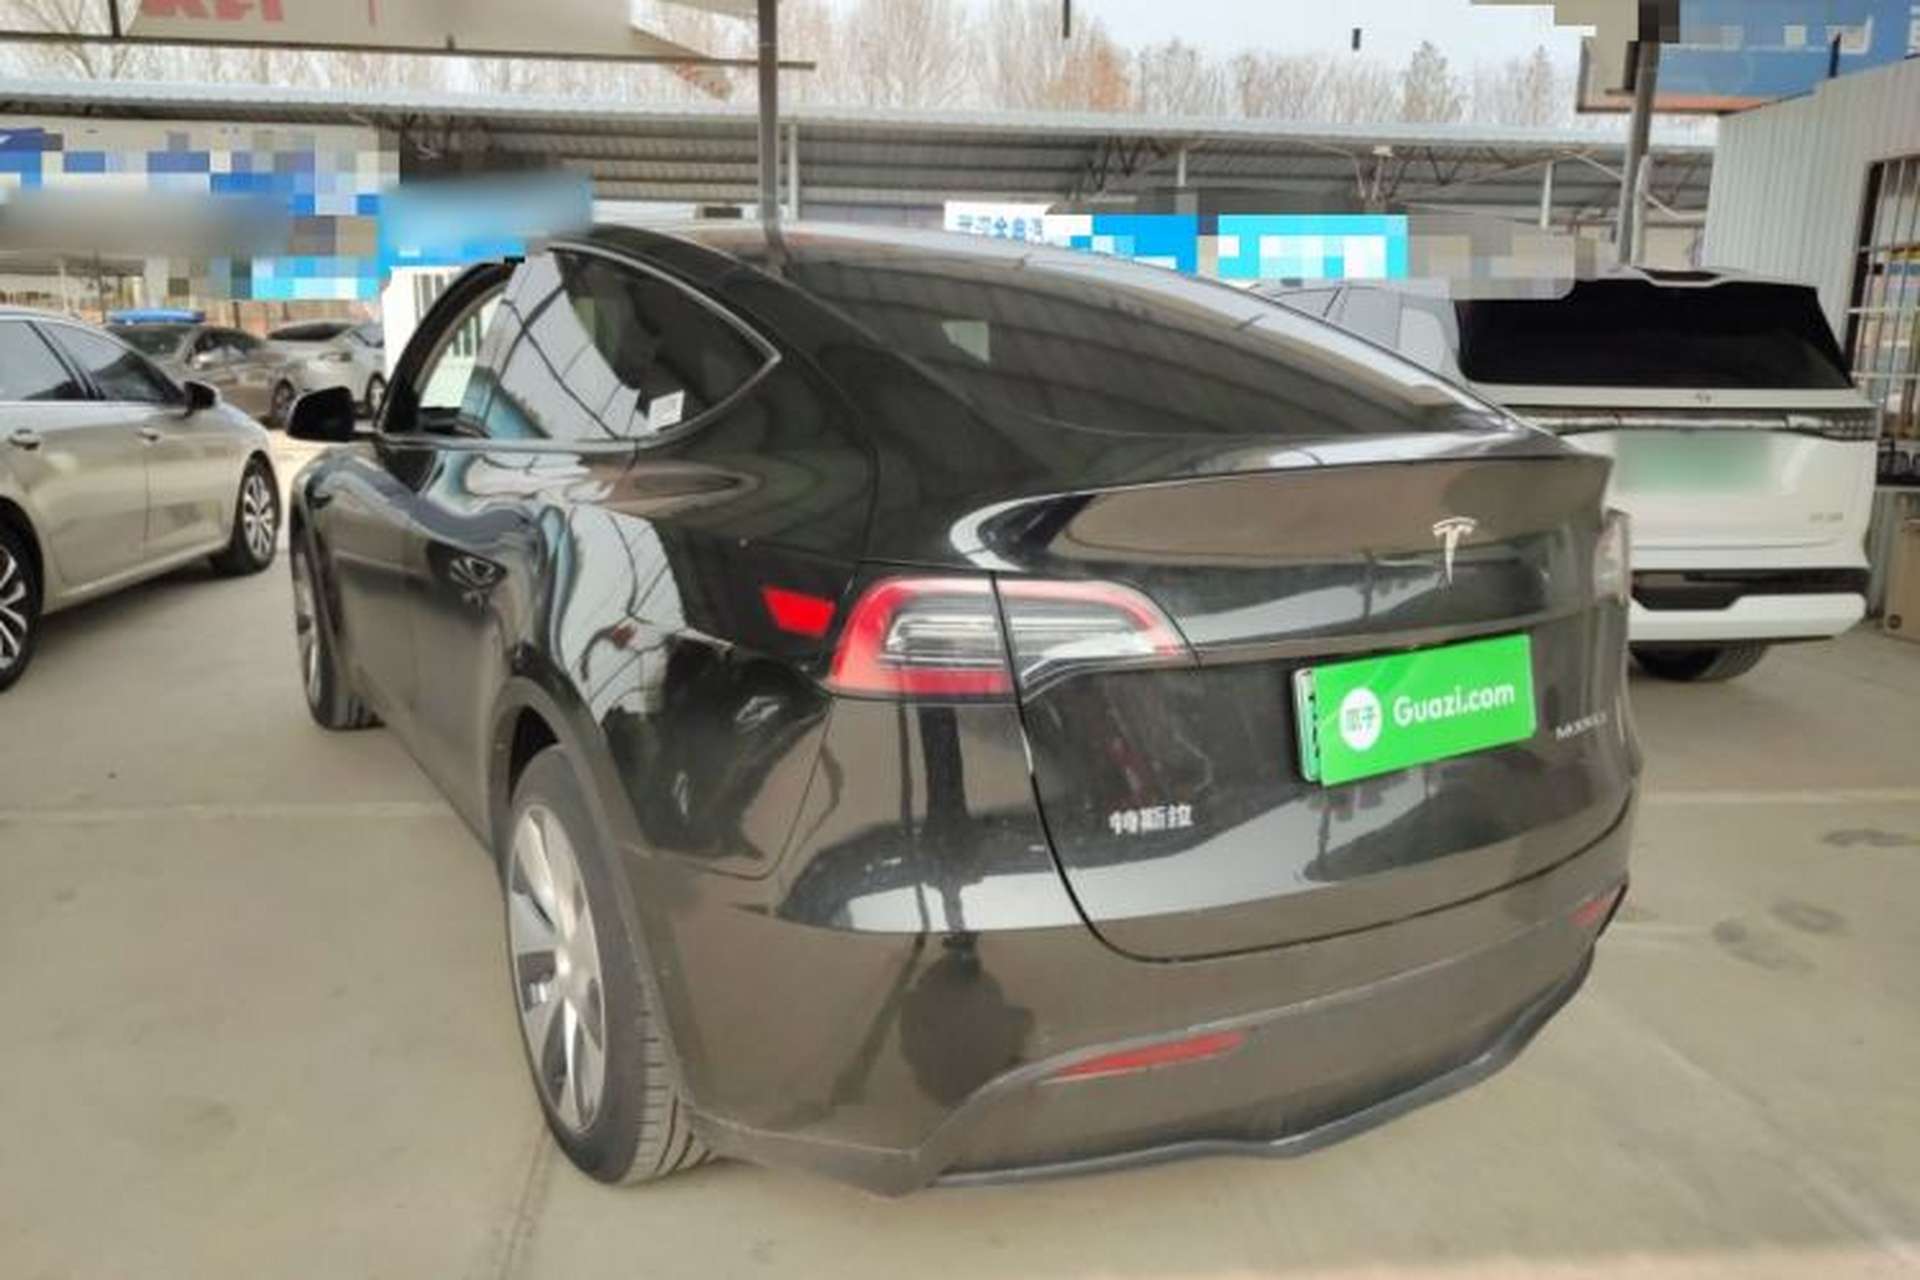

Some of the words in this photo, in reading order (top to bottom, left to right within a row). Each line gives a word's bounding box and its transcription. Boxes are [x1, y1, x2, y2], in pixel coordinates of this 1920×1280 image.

[1393, 684, 1516, 728] Guazi.com
[1108, 804, 1195, 835] 特斯拉
